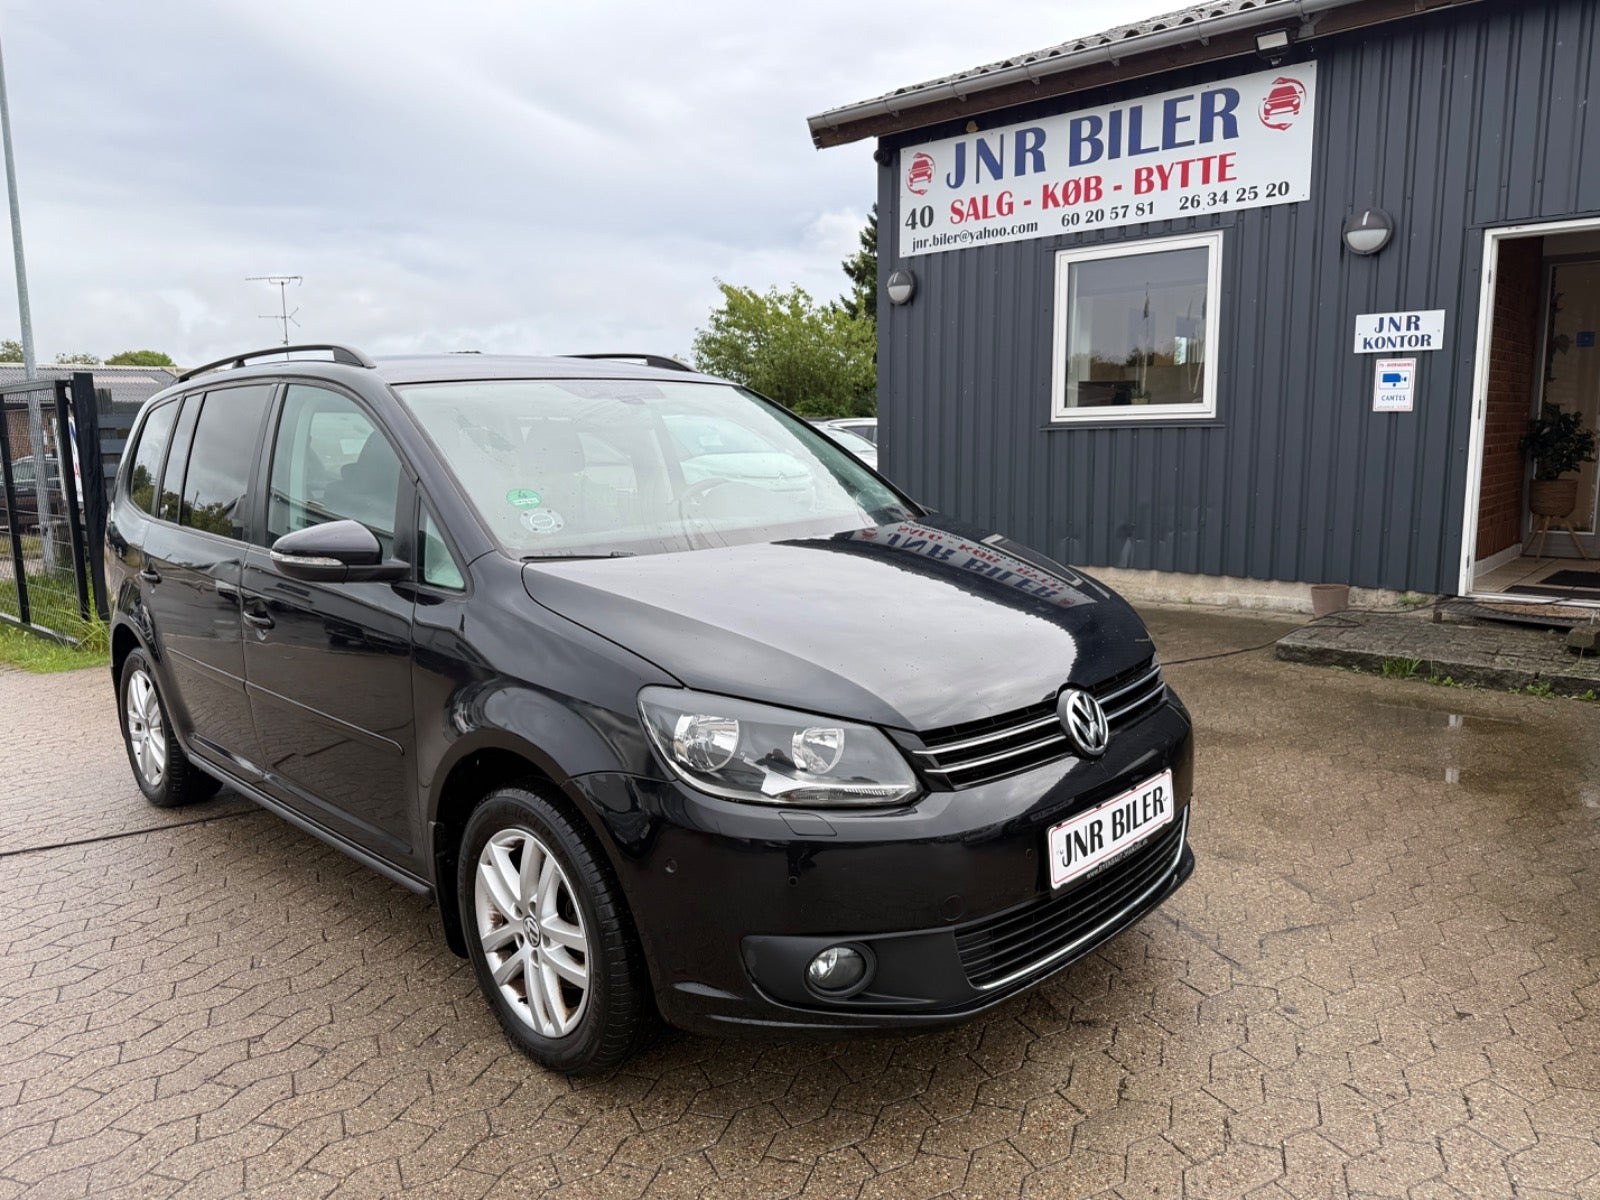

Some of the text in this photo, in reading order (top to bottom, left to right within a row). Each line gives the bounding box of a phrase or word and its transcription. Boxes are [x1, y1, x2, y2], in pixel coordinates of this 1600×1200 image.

[945, 87, 1240, 189] JNR BILER
[950, 190, 1014, 224] SALG
[1042, 175, 1103, 210] KØB
[1134, 152, 1237, 195] BYTTE
[1179, 181, 1289, 210] 26 34 25 20
[905, 205, 934, 230] 40
[1061, 201, 1154, 227] 60 20 57 81
[912, 222, 1038, 252] jnr.biler@yahoo.com
[1374, 314, 1421, 334] JNR
[1363, 334, 1432, 350] KONTOR
[1062, 819, 1104, 868] JNR
[1111, 785, 1164, 842] BILER
